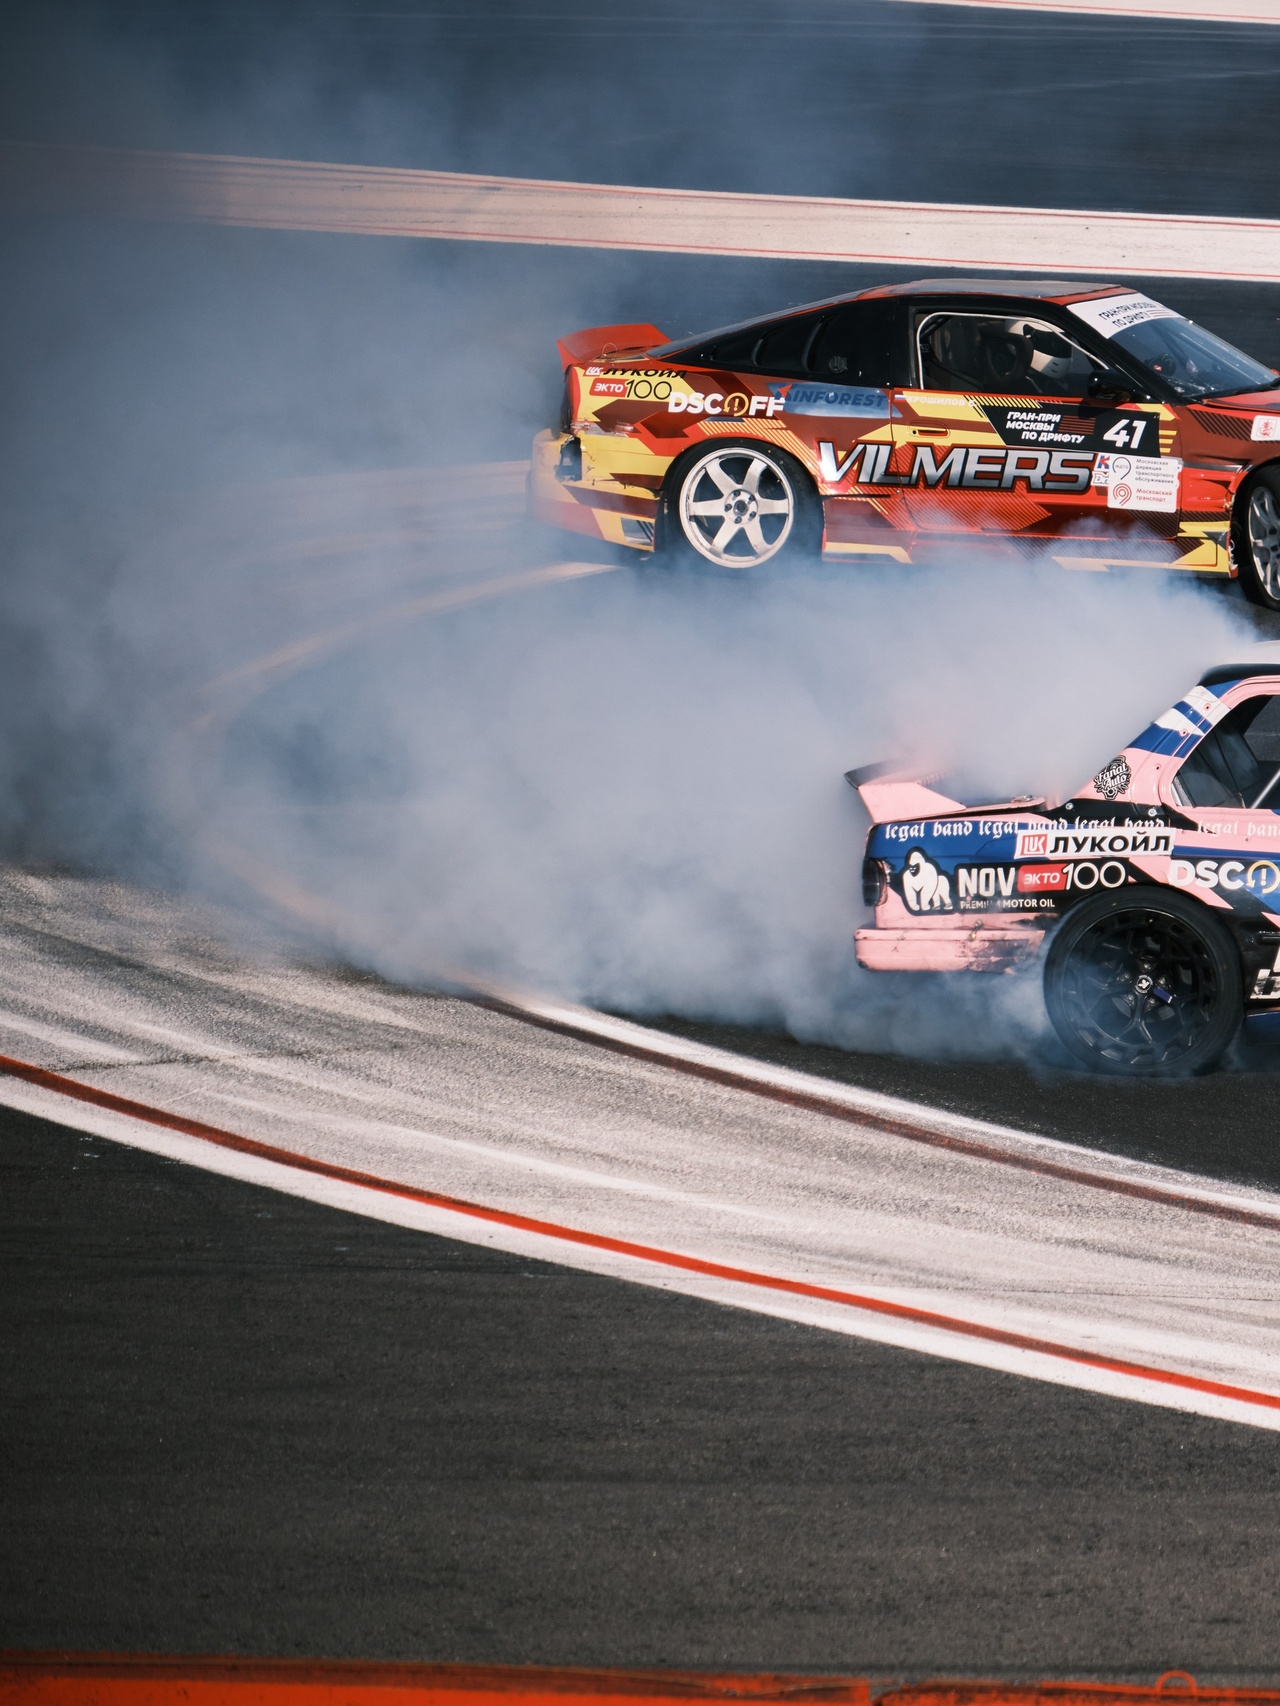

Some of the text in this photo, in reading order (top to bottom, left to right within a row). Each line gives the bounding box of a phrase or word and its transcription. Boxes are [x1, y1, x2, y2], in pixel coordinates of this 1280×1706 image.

[602, 367, 688, 379] ЛУКОЙЛ
[594, 383, 624, 393] ЭКТО
[626, 379, 672, 400] 100
[1006, 411, 1062, 423] ГРАН-ПРИ
[1005, 420, 1055, 432] МОСКВЫ
[1021, 430, 1086, 444] ПО ДРИФТУ
[1102, 418, 1148, 449] 41
[817, 440, 1095, 491] VILMERS
[885, 820, 925, 842] legal
[933, 820, 972, 837] band
[979, 819, 1019, 840] legal
[1050, 831, 1172, 854] ЛУКОЙЛ
[1024, 872, 1060, 885] ЭКТО
[1062, 861, 1126, 890] 100
[1003, 898, 1038, 908] MOTOR
[1039, 898, 1055, 908] OIL
